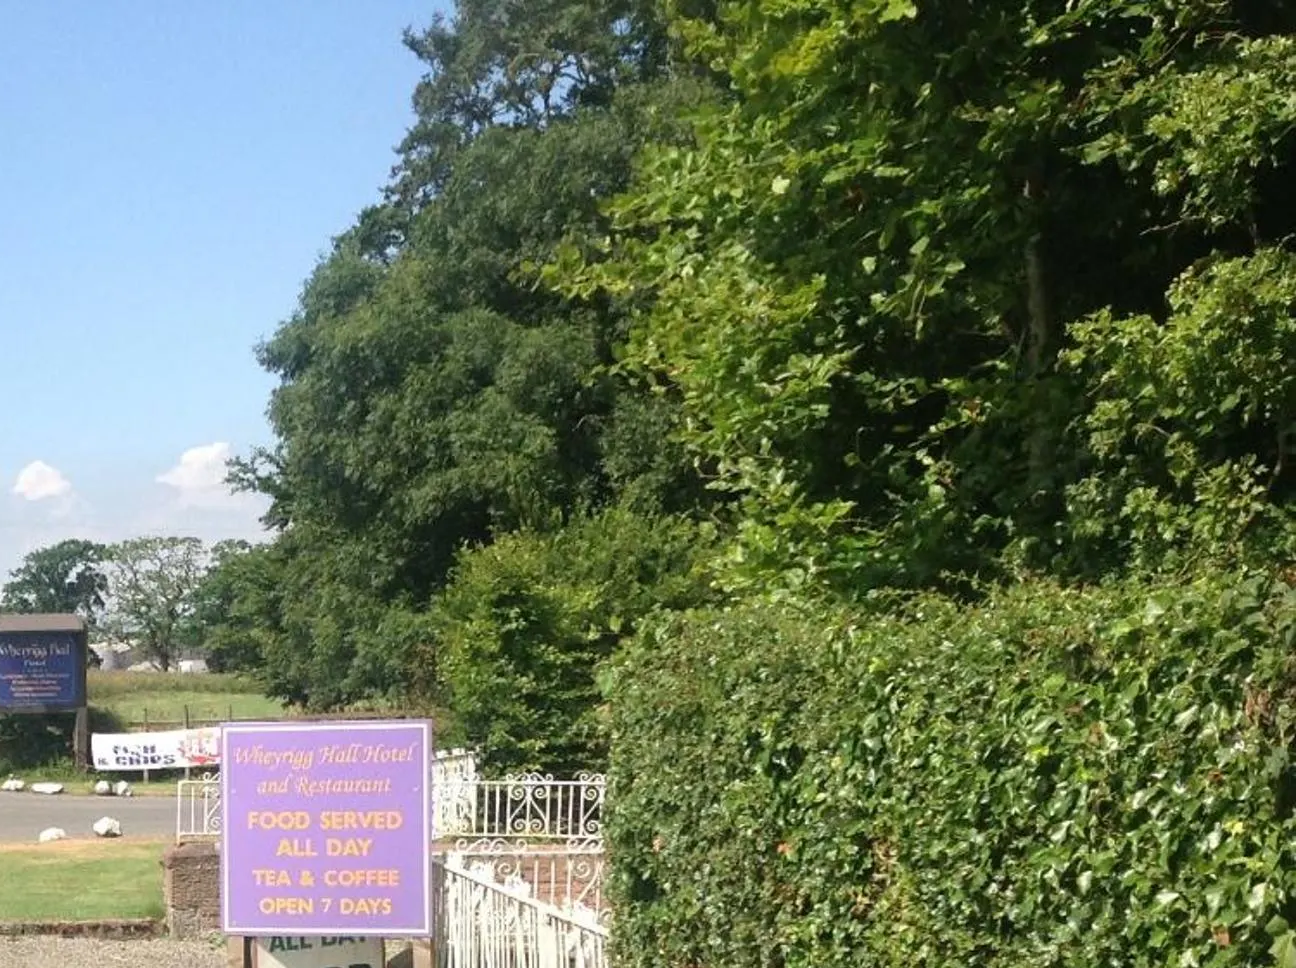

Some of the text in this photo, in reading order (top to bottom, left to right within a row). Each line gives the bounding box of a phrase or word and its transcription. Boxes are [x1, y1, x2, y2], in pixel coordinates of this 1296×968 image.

[235, 742, 418, 769] Wheyrigg Hall Hotel
[256, 773, 392, 796] and Restaurant
[247, 811, 403, 830] FOOD SERVED
[276, 838, 373, 857] ALL DAY
[252, 870, 400, 887] TEA & COFFEE
[259, 898, 392, 915] OPEN 7 DAYS
